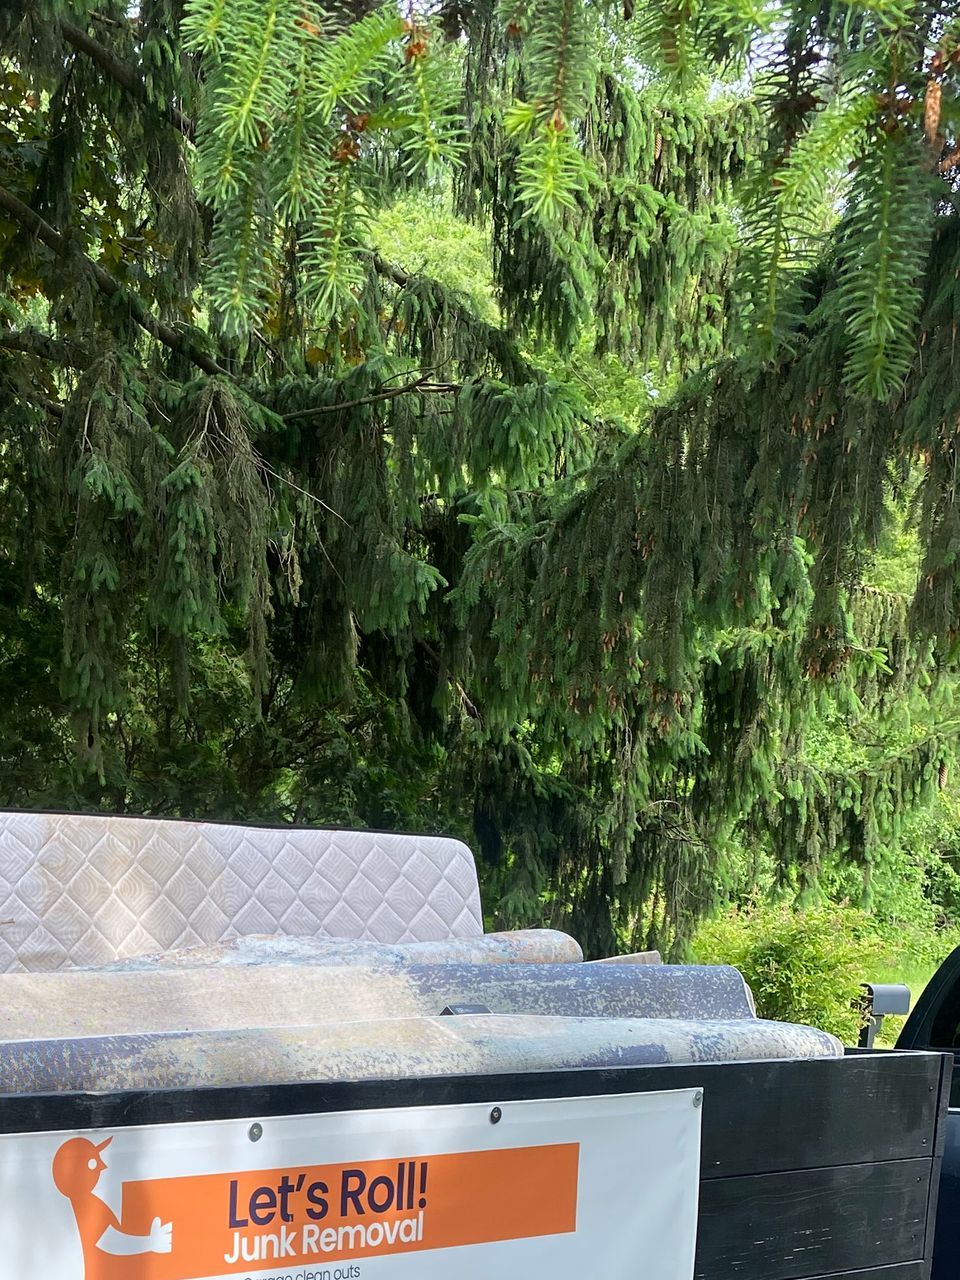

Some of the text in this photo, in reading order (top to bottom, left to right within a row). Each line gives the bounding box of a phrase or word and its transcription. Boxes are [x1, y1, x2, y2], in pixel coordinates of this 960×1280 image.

[228, 1161, 428, 1229] Let's Roll!
[224, 1210, 424, 1264] Junk Removal
[334, 1265, 361, 1280] outs
